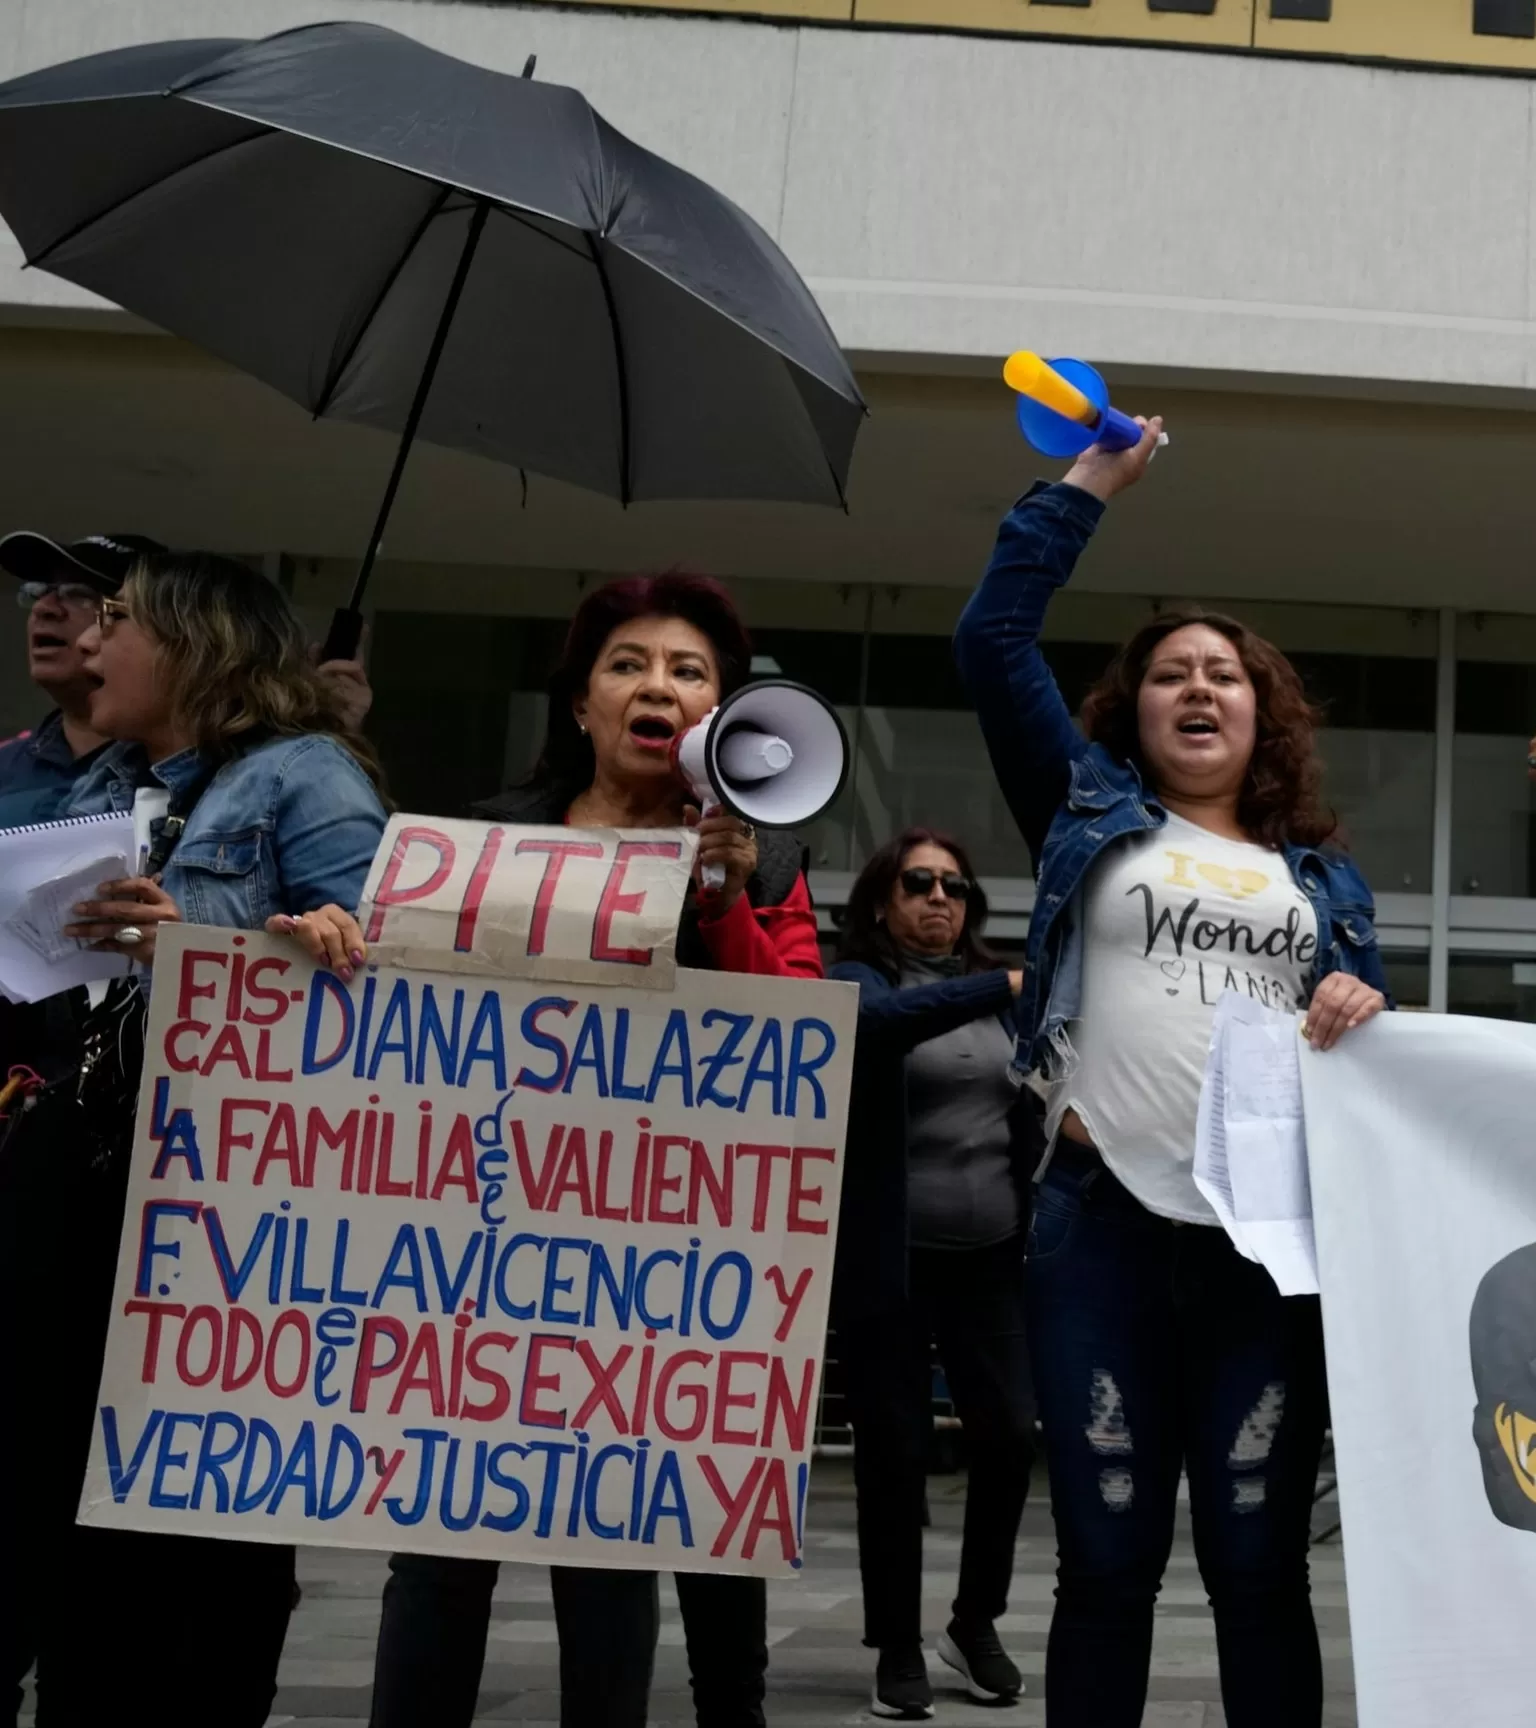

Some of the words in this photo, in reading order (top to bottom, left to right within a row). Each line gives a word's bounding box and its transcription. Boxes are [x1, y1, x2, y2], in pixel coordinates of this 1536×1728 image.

[364, 826, 683, 966] PITE
[1125, 883, 1317, 965] Wonde
[1164, 851, 1197, 889] I
[164, 1020, 294, 1083] CAL
[301, 964, 507, 1092] DIANA
[513, 996, 837, 1119] SALAZAR
[150, 1075, 205, 1182] LA
[216, 1094, 480, 1204] FAMILIA
[509, 1116, 837, 1235] VALIENTE
[134, 1198, 204, 1298] F.
[201, 1200, 752, 1340] VILLAVICENCIO
[124, 1299, 312, 1398] TODO
[518, 1327, 816, 1453] EXIGEN
[100, 1405, 364, 1521] VERDAD
[382, 1428, 696, 1549] JUSTICIA
[696, 1454, 808, 1570] YA!
